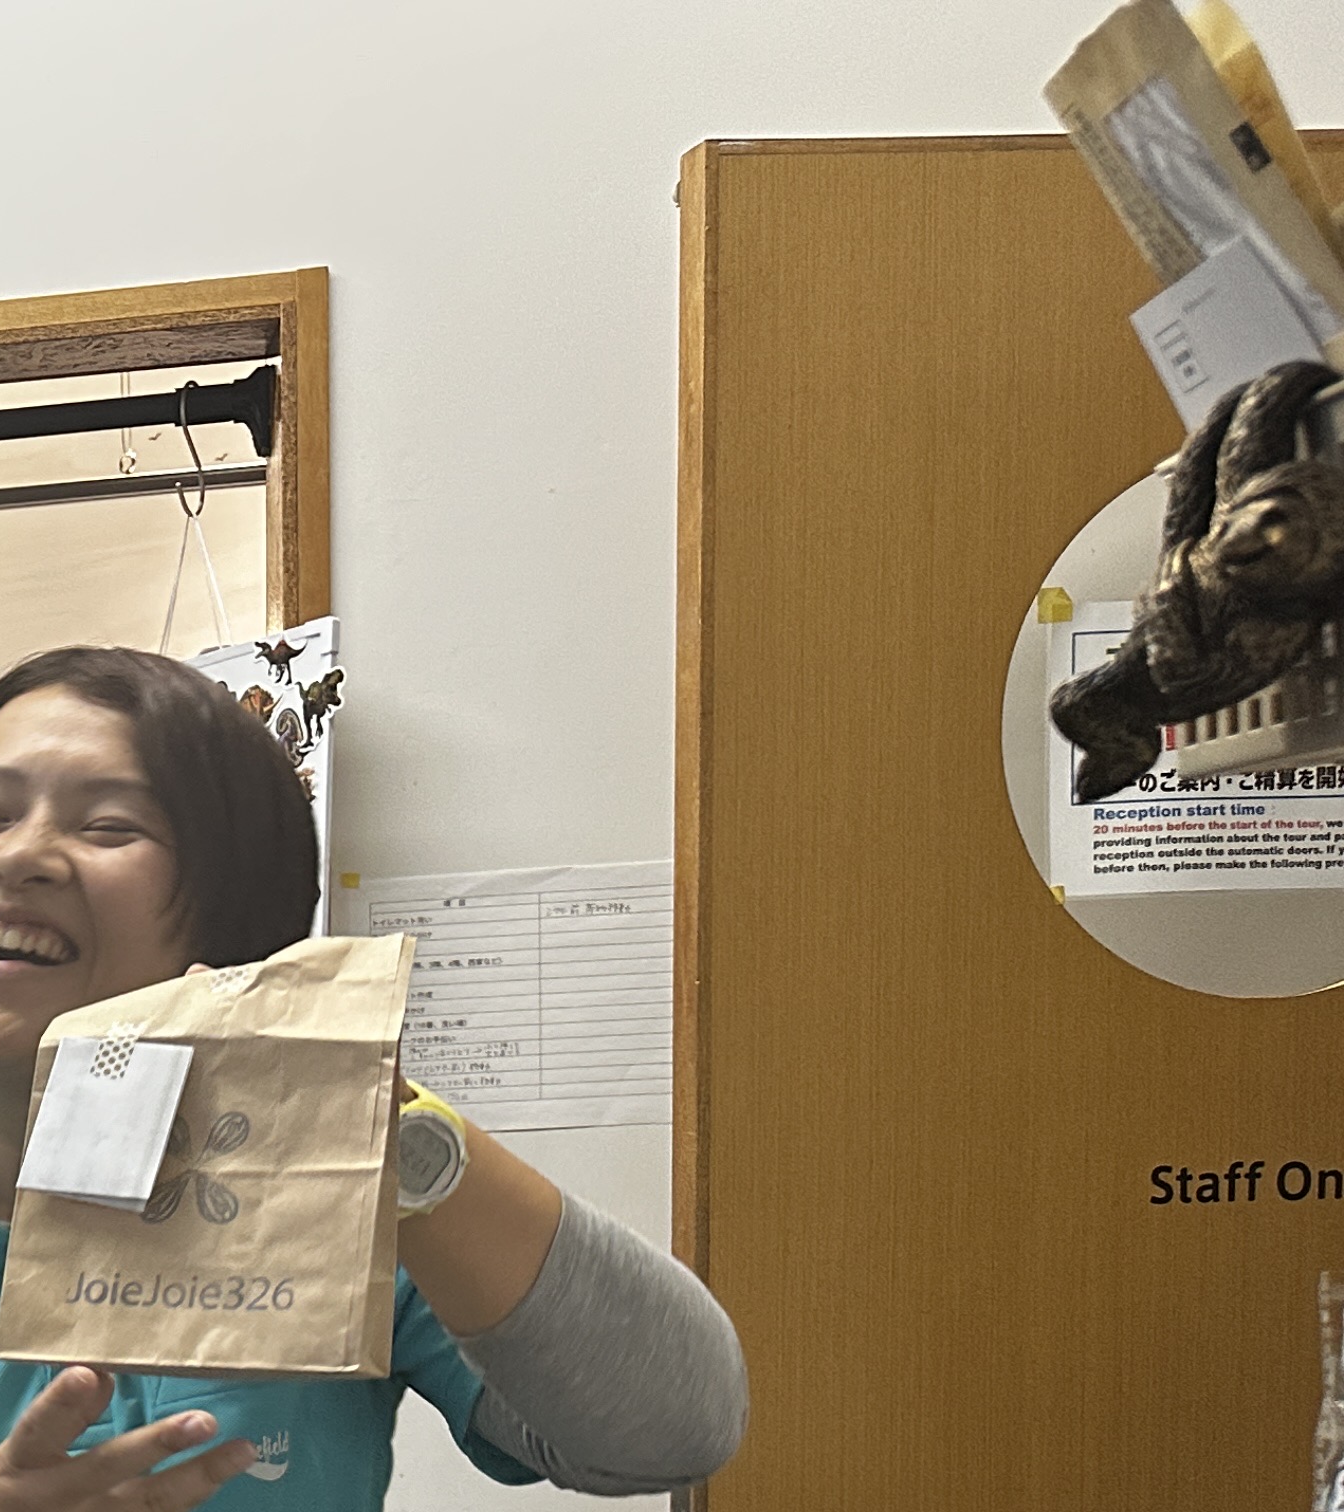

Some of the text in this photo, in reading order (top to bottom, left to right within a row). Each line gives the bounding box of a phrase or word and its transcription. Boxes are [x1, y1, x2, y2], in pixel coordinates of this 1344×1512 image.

[1093, 803, 1265, 821] Reception start time
[1093, 825, 1109, 834] 20
[1112, 823, 1163, 833] minutes
[1166, 821, 1205, 831] before
[1208, 820, 1227, 829] the
[1230, 820, 1257, 829] start
[1260, 820, 1272, 829] of
[1275, 820, 1294, 829] the
[1297, 820, 1324, 830] tour,
[1093, 837, 1152, 850] providing
[1155, 834, 1224, 845] information
[1226, 834, 1259, 843] about
[1262, 833, 1280, 842] the
[1283, 833, 1307, 842] tour
[1310, 832, 1331, 841] and
[1093, 850, 1154, 861] reception
[1157, 848, 1202, 857] outside
[1205, 847, 1224, 856] the
[1227, 846, 1284, 856] automatic
[1287, 846, 1323, 855] doors.
[1093, 864, 1134, 874] before
[1173, 861, 1212, 872] please
[1215, 860, 1246, 869] make
[1249, 860, 1267, 869] the
[1270, 859, 1322, 870] following
[1150, 1160, 1265, 1204] Staff
[66, 1271, 295, 1312] JoieJoie326
